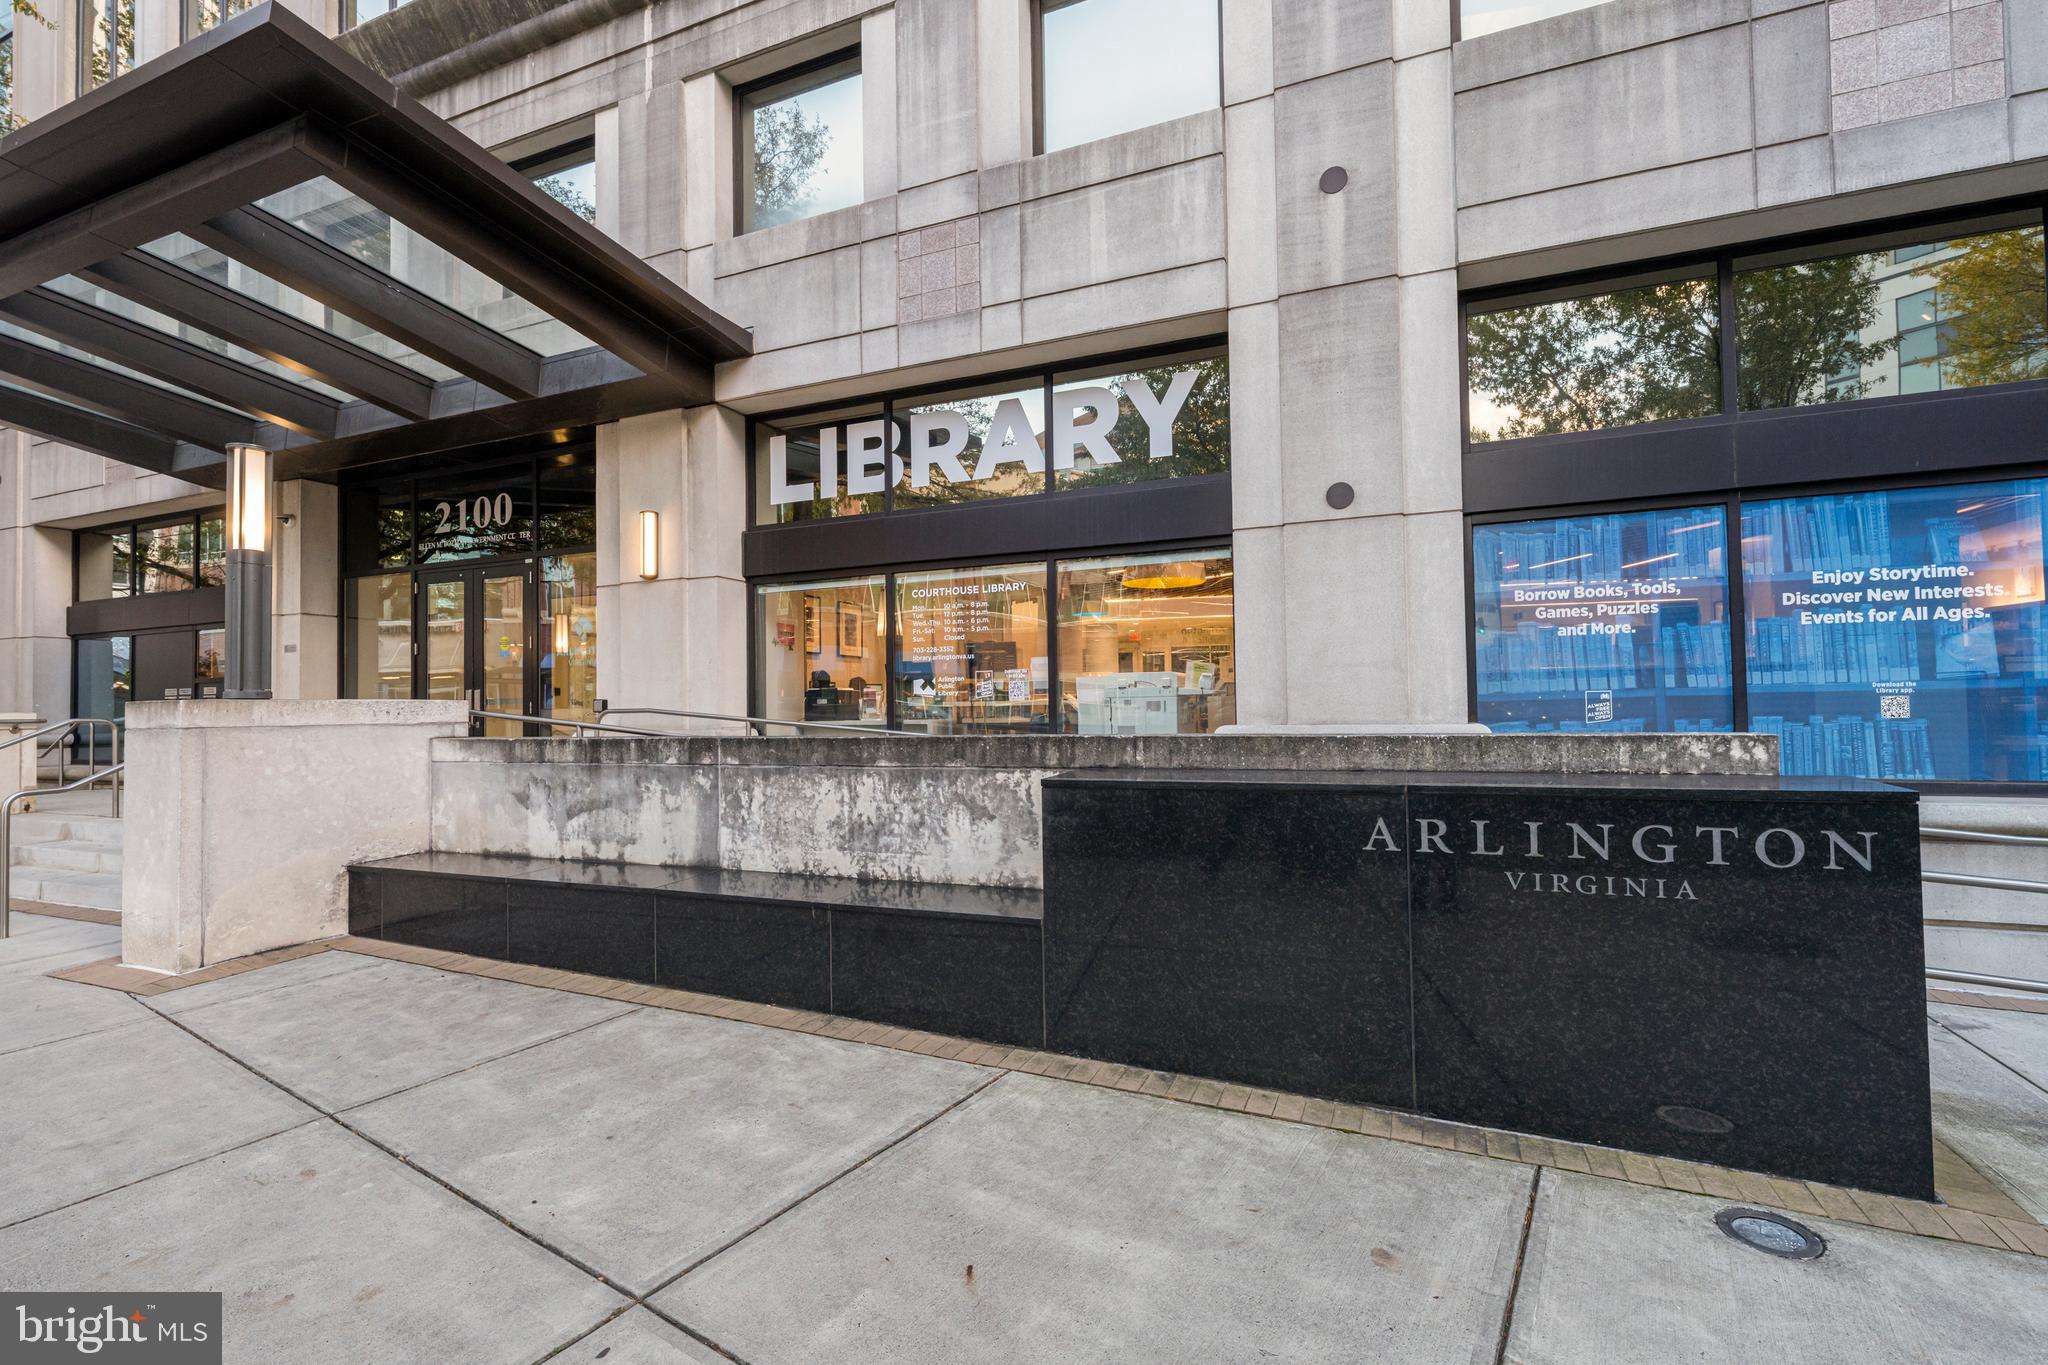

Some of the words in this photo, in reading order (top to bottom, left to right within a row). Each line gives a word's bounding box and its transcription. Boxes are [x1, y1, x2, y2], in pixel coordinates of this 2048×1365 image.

[770, 370, 1198, 505] LIBRARY
[434, 492, 513, 534] 2100
[1811, 569, 1864, 586] Enjoy
[1868, 564, 1975, 582] Storytime.
[911, 586, 979, 598] COURTHOUSE
[982, 581, 1027, 593] LIBRARY
[1514, 588, 1570, 602] Borrow
[1573, 584, 1628, 599] Books,
[1631, 581, 1681, 596] Tools,
[1782, 590, 1863, 606] Discover
[1867, 588, 1910, 602] New
[1914, 582, 2011, 600] Interests.
[1535, 606, 1593, 620] Games,
[1596, 602, 1660, 617] Puzzles
[1800, 611, 1864, 625] Events
[1867, 608, 1897, 623] for
[1900, 606, 1928, 621] All
[1932, 605, 1991, 622] Ages.
[1557, 623, 1587, 637] and
[1590, 622, 1636, 636] More.
[912, 654, 975, 663] library.arlingtonva.us
[1362, 816, 1878, 872] ARLINGTON
[1504, 870, 1699, 900] VIRGINIA
